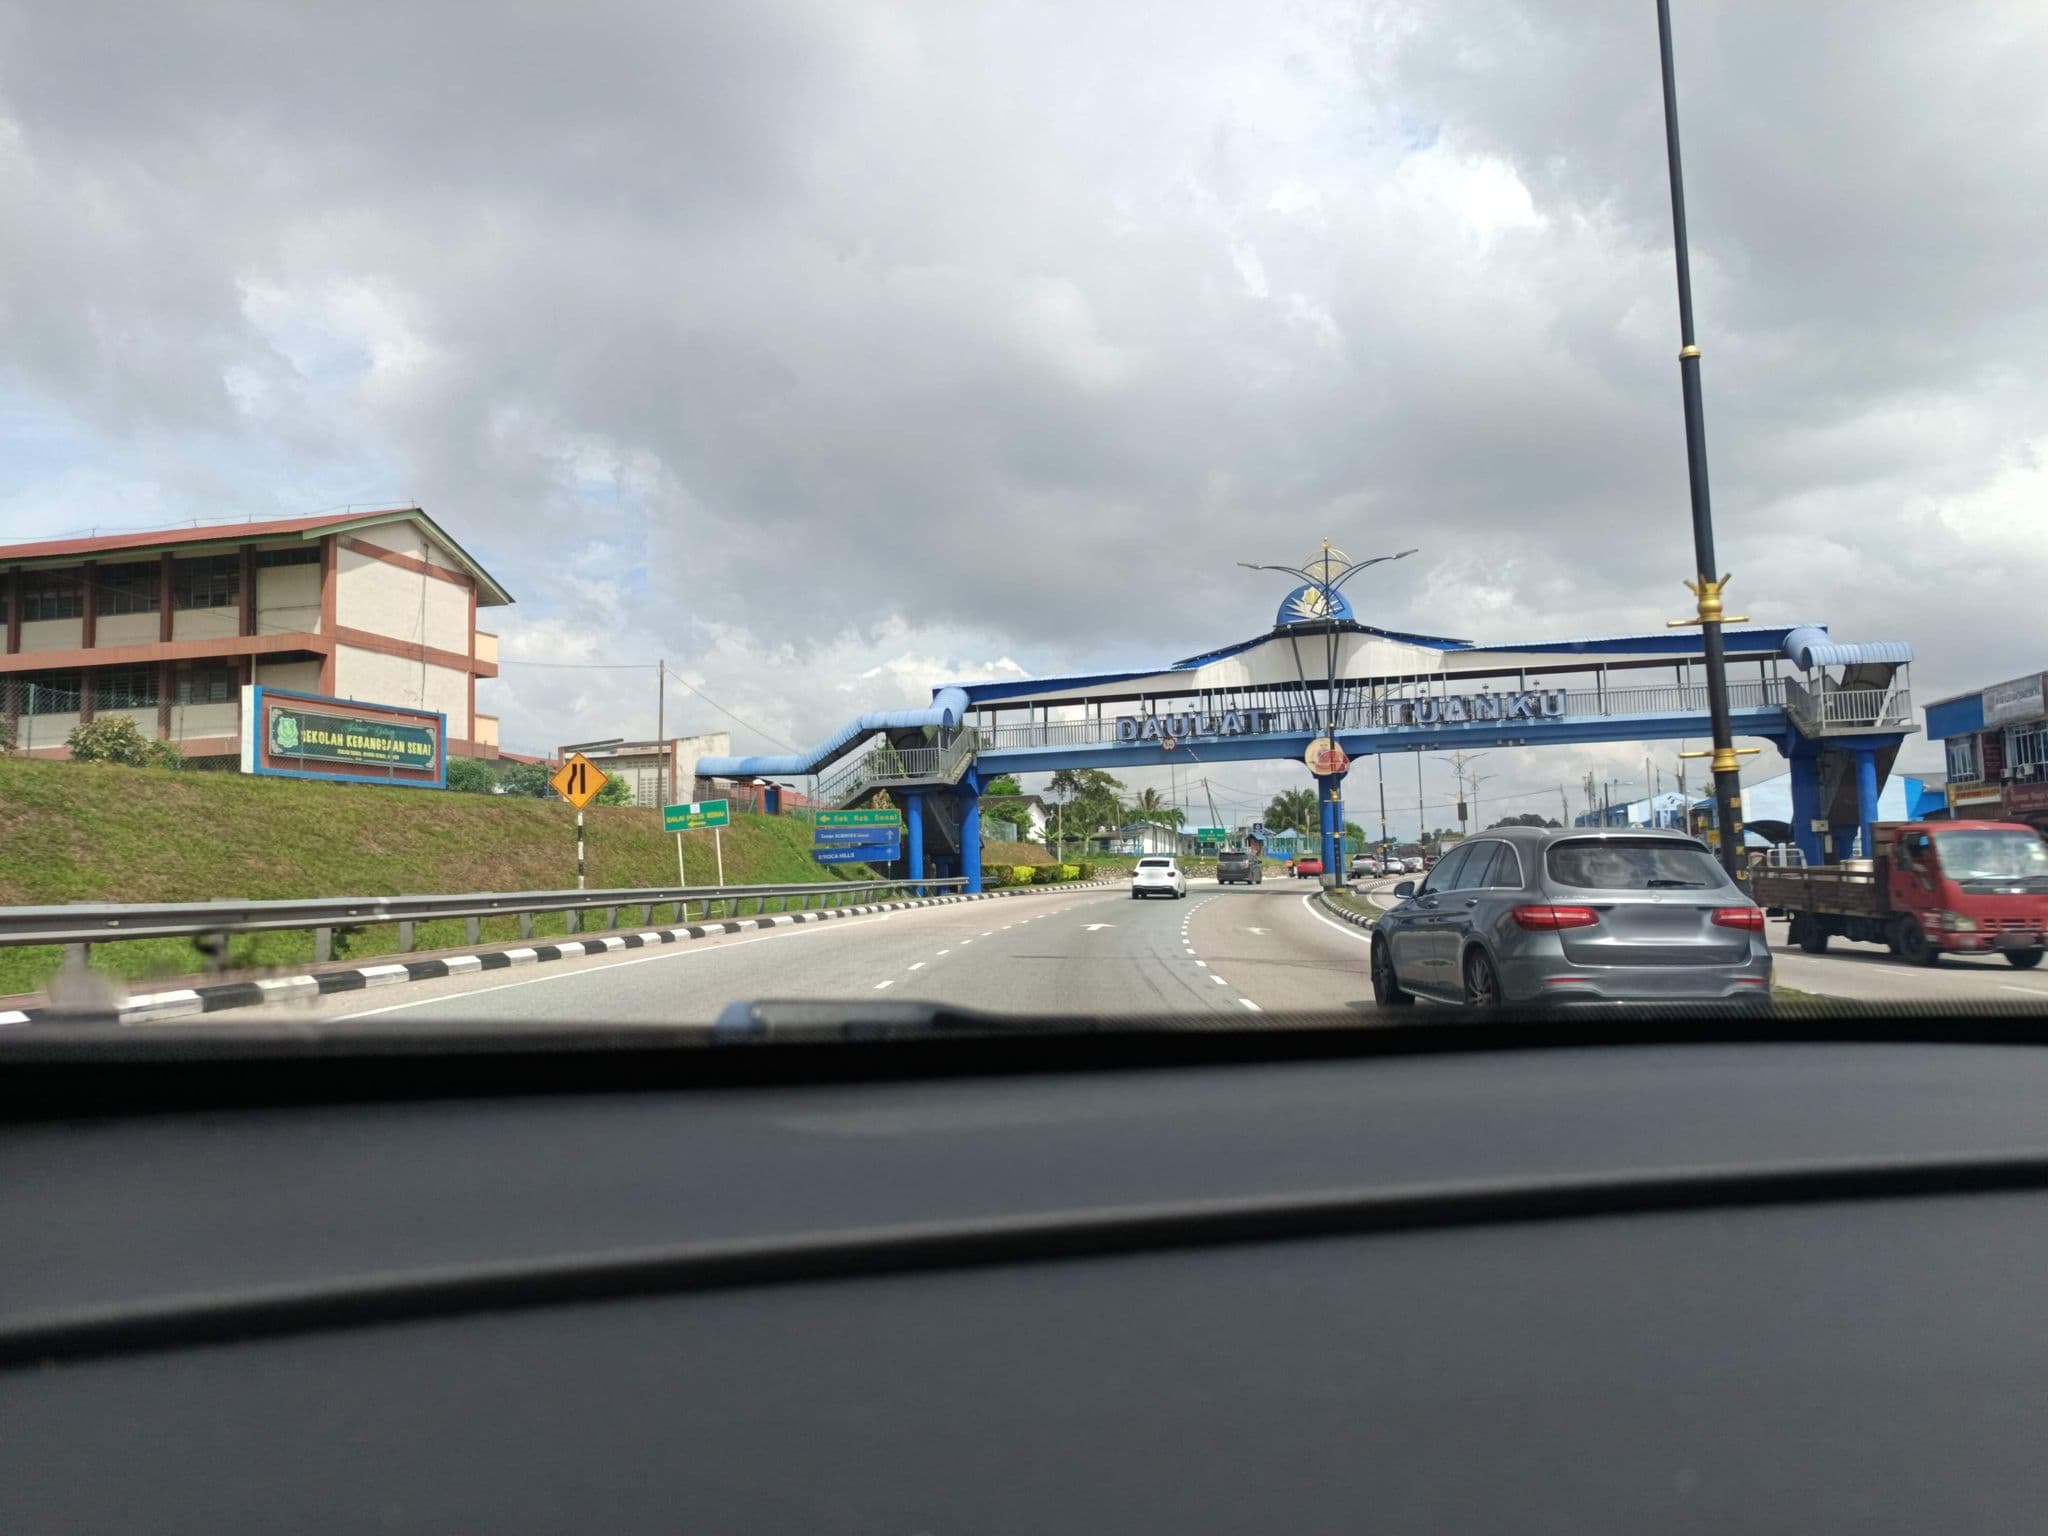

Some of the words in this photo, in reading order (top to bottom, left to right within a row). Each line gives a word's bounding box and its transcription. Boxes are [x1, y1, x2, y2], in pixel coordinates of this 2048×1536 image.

[1116, 708, 1266, 740] DAULAT
[1386, 688, 1567, 724] TUANKU
[303, 729, 343, 747] SEKOLAH
[346, 732, 405, 753] KEBANGSAAN
[407, 741, 432, 756] SENAI
